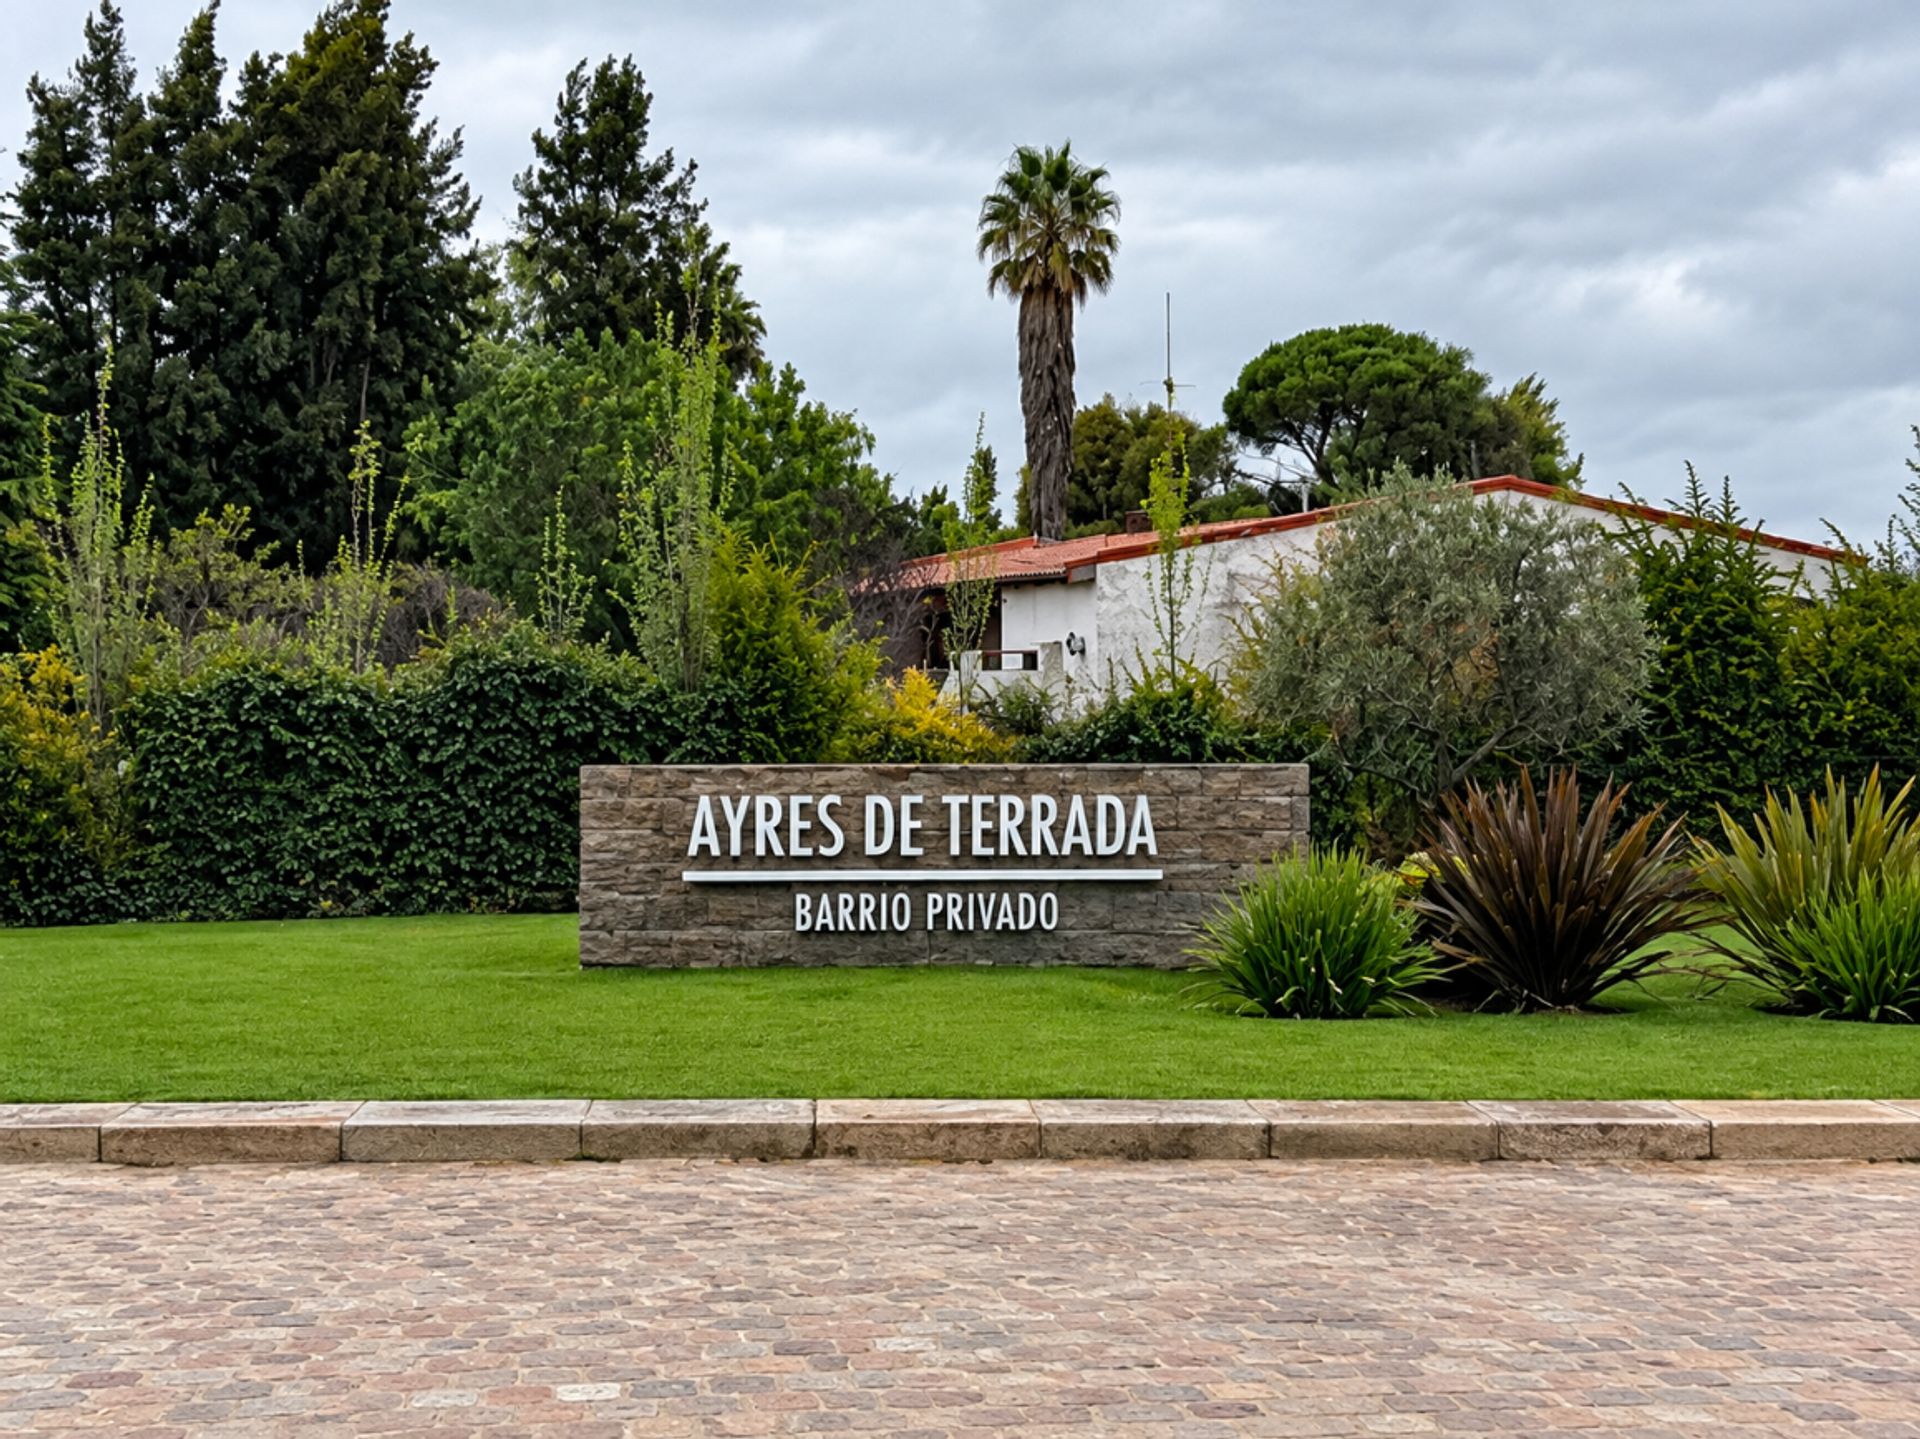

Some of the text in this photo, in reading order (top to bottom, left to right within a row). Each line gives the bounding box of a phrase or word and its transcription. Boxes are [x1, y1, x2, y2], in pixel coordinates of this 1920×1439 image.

[687, 794, 1158, 857] AYRES DE TERRADA
[795, 892, 1058, 931] BARRIO PRIVADO
